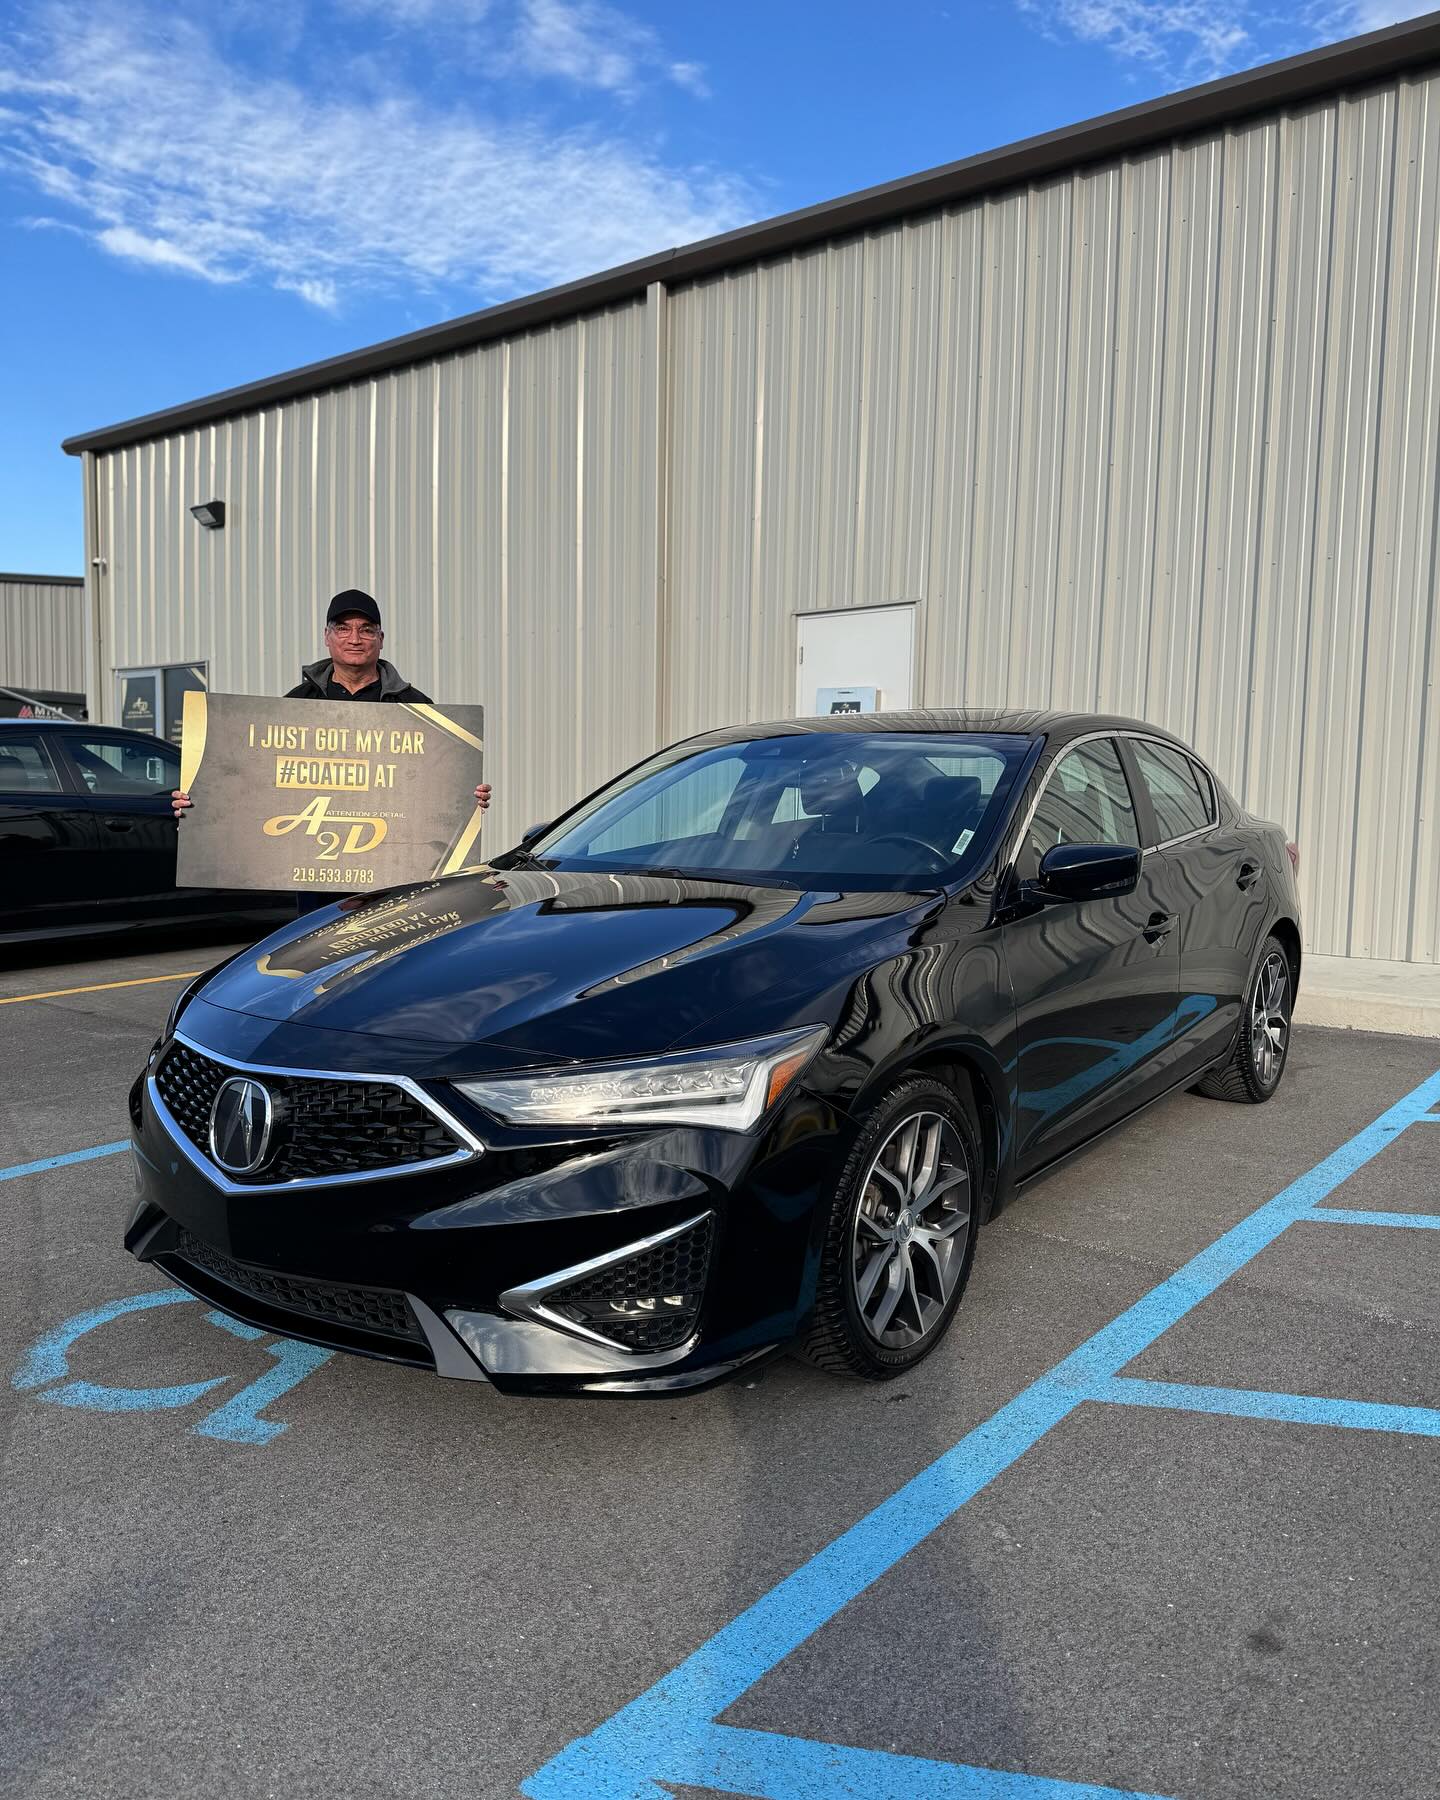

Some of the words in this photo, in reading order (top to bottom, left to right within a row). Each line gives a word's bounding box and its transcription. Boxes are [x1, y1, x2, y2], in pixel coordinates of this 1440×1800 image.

[249, 724, 255, 747] I
[260, 725, 309, 750] JUST
[315, 728, 350, 752] GOT
[356, 729, 384, 753] MY
[390, 731, 425, 755] CAR
[279, 760, 367, 787] #COATED
[374, 764, 397, 788] AT
[379, 811, 407, 819] DETAIL
[293, 867, 374, 884] 219.533.8783
